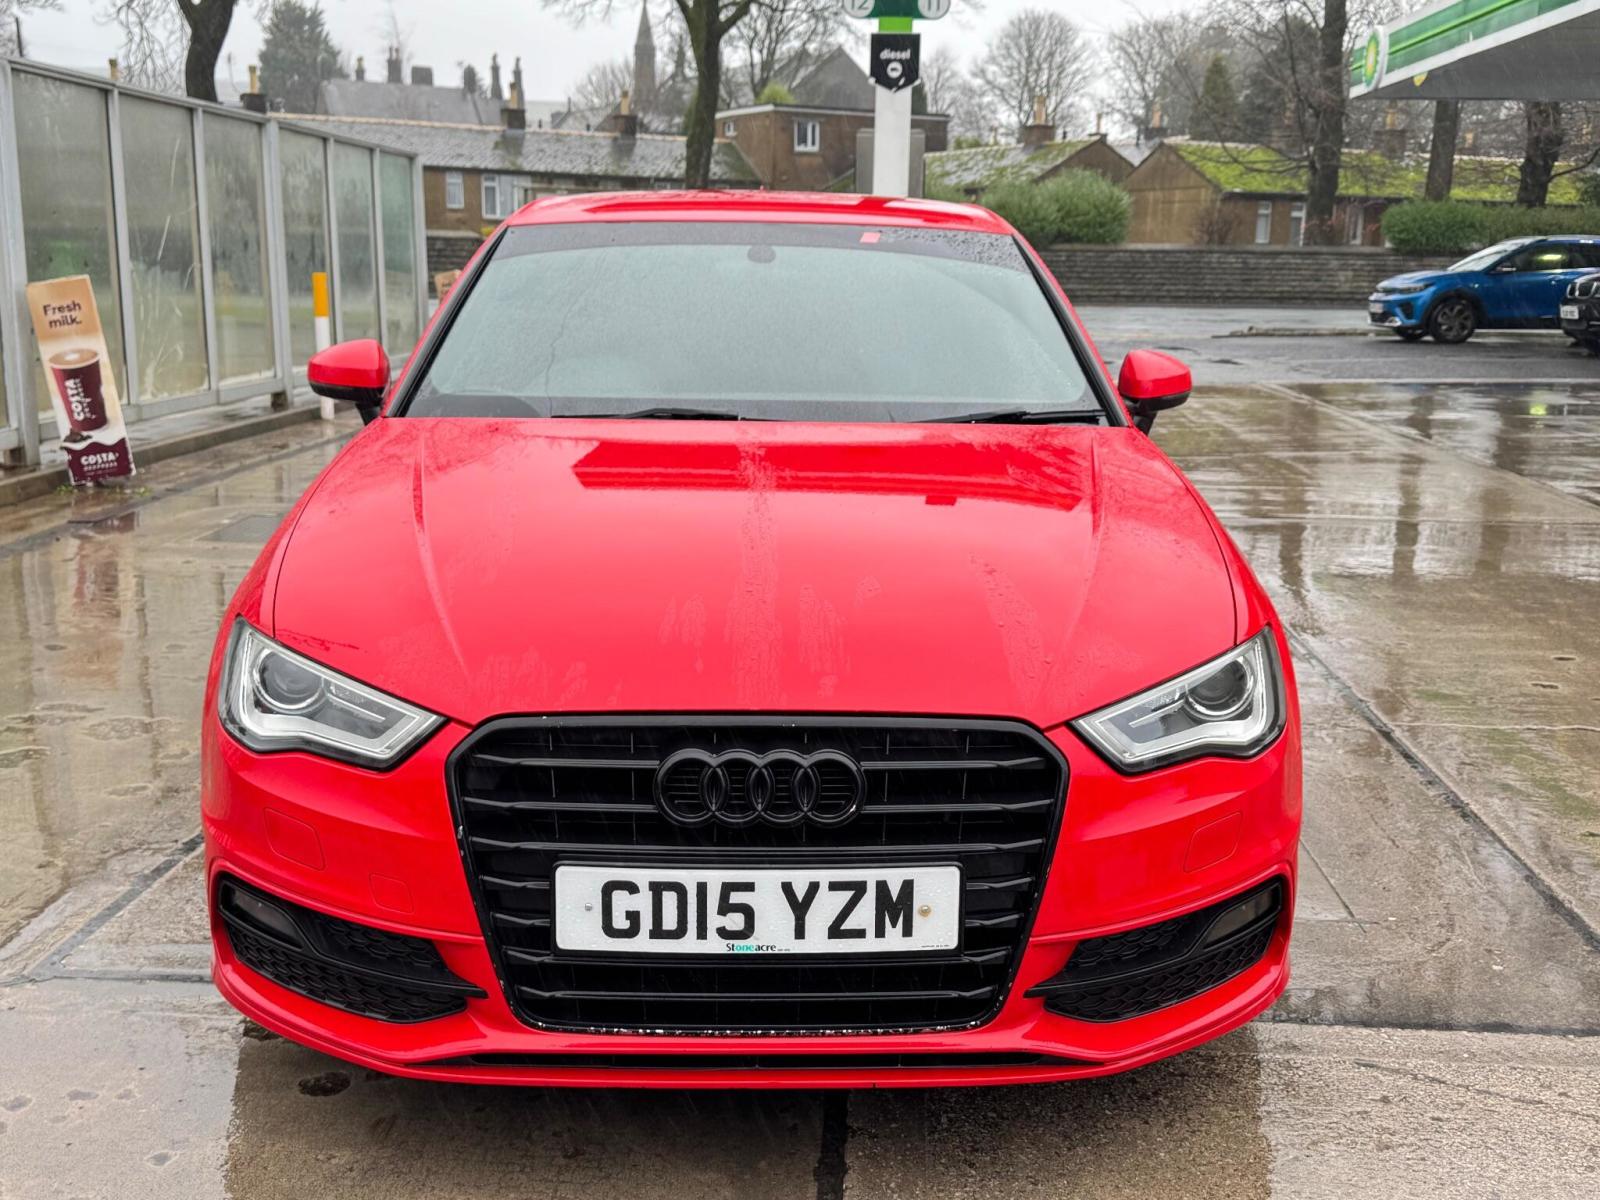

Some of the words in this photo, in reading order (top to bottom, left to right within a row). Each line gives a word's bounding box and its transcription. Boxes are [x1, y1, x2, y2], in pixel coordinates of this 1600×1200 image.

[879, 48, 911, 60] diesel
[43, 300, 82, 316] Fresh
[48, 314, 83, 329] milk.
[64, 378, 85, 421] COSTA
[80, 452, 117, 466] COSTA
[601, 879, 756, 941] GD15
[780, 878, 915, 940] YZM
[726, 942, 777, 952] Stoneacre
